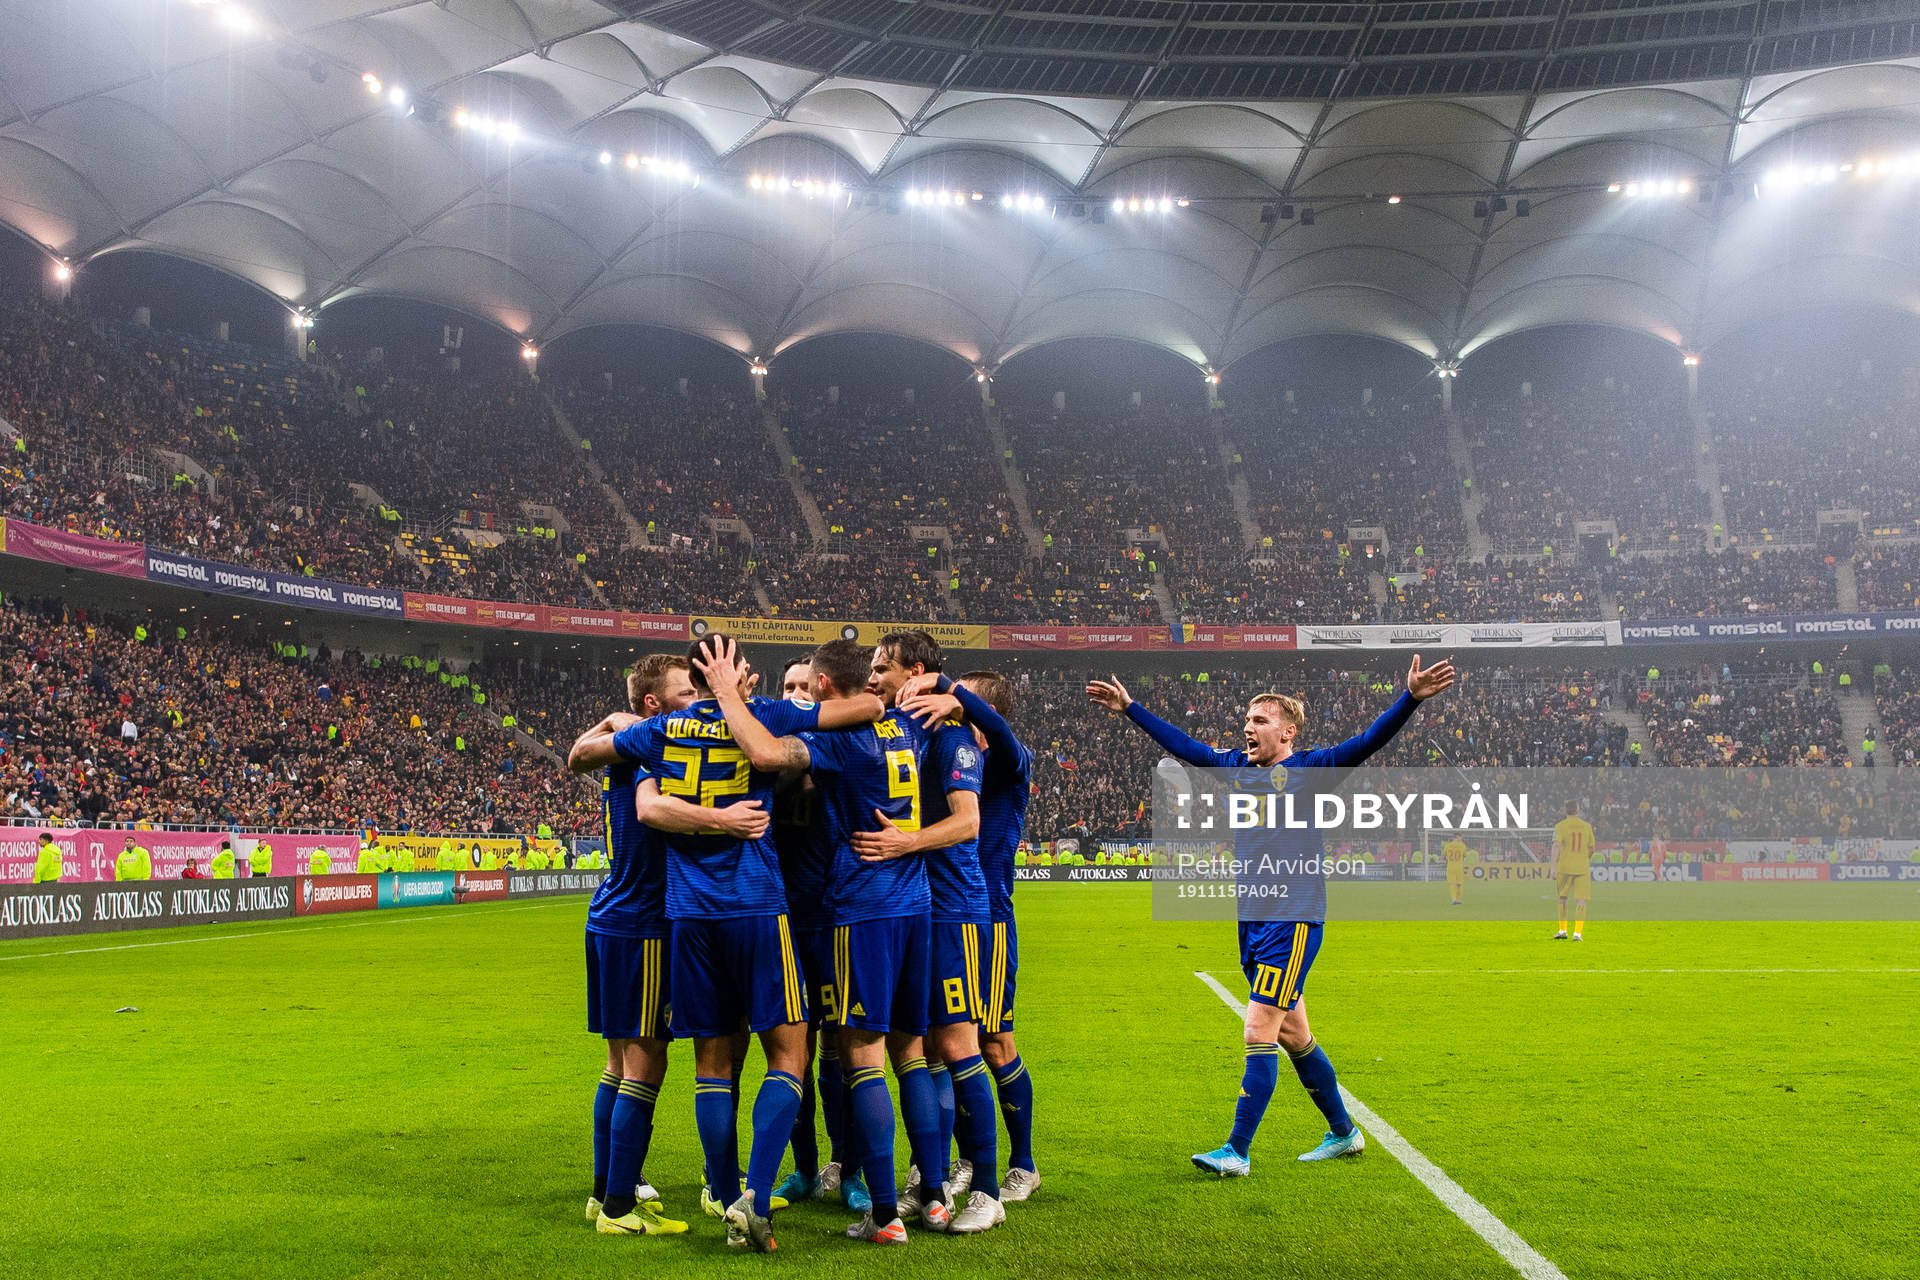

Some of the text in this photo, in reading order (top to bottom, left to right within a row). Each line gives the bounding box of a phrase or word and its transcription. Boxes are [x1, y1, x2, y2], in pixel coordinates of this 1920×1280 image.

[727, 620, 739, 628] TU
[876, 626, 888, 634] TU
[886, 751, 921, 833] 9
[0, 842, 38, 858] PONSOR
[152, 846, 184, 860] SPONSOR
[1448, 850, 1460, 862] 20
[1068, 868, 1128, 880] AUTOKLASS
[236, 886, 288, 912] AUTOKLASS
[314, 884, 372, 902] EUROPEAN QUALIFIERS
[404, 880, 444, 896] UEFA EURO 2020
[0, 894, 82, 930] AUTOKLASS
[93, 890, 162, 920] AUTOKLASS
[170, 888, 230, 916] AUTOKLASS
[1252, 964, 1282, 998] 10
[821, 984, 840, 1022] 9
[943, 977, 966, 1014] 8
